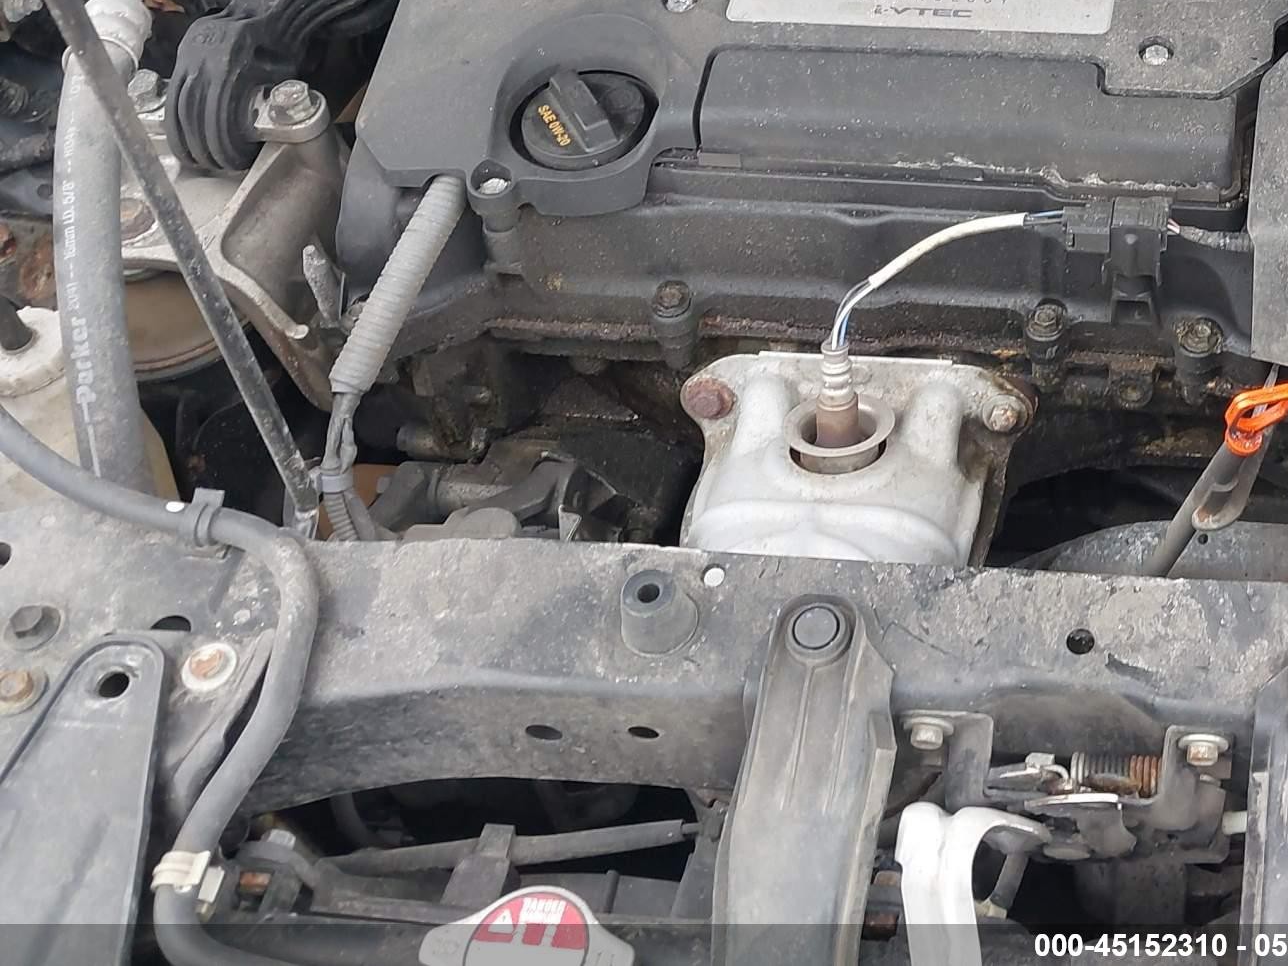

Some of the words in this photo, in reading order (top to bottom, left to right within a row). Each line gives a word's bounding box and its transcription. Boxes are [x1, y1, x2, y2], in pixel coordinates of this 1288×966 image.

[538, 104, 557, 124] SAE
[548, 121, 572, 147] 0W-20
[70, 316, 97, 404] Parker
